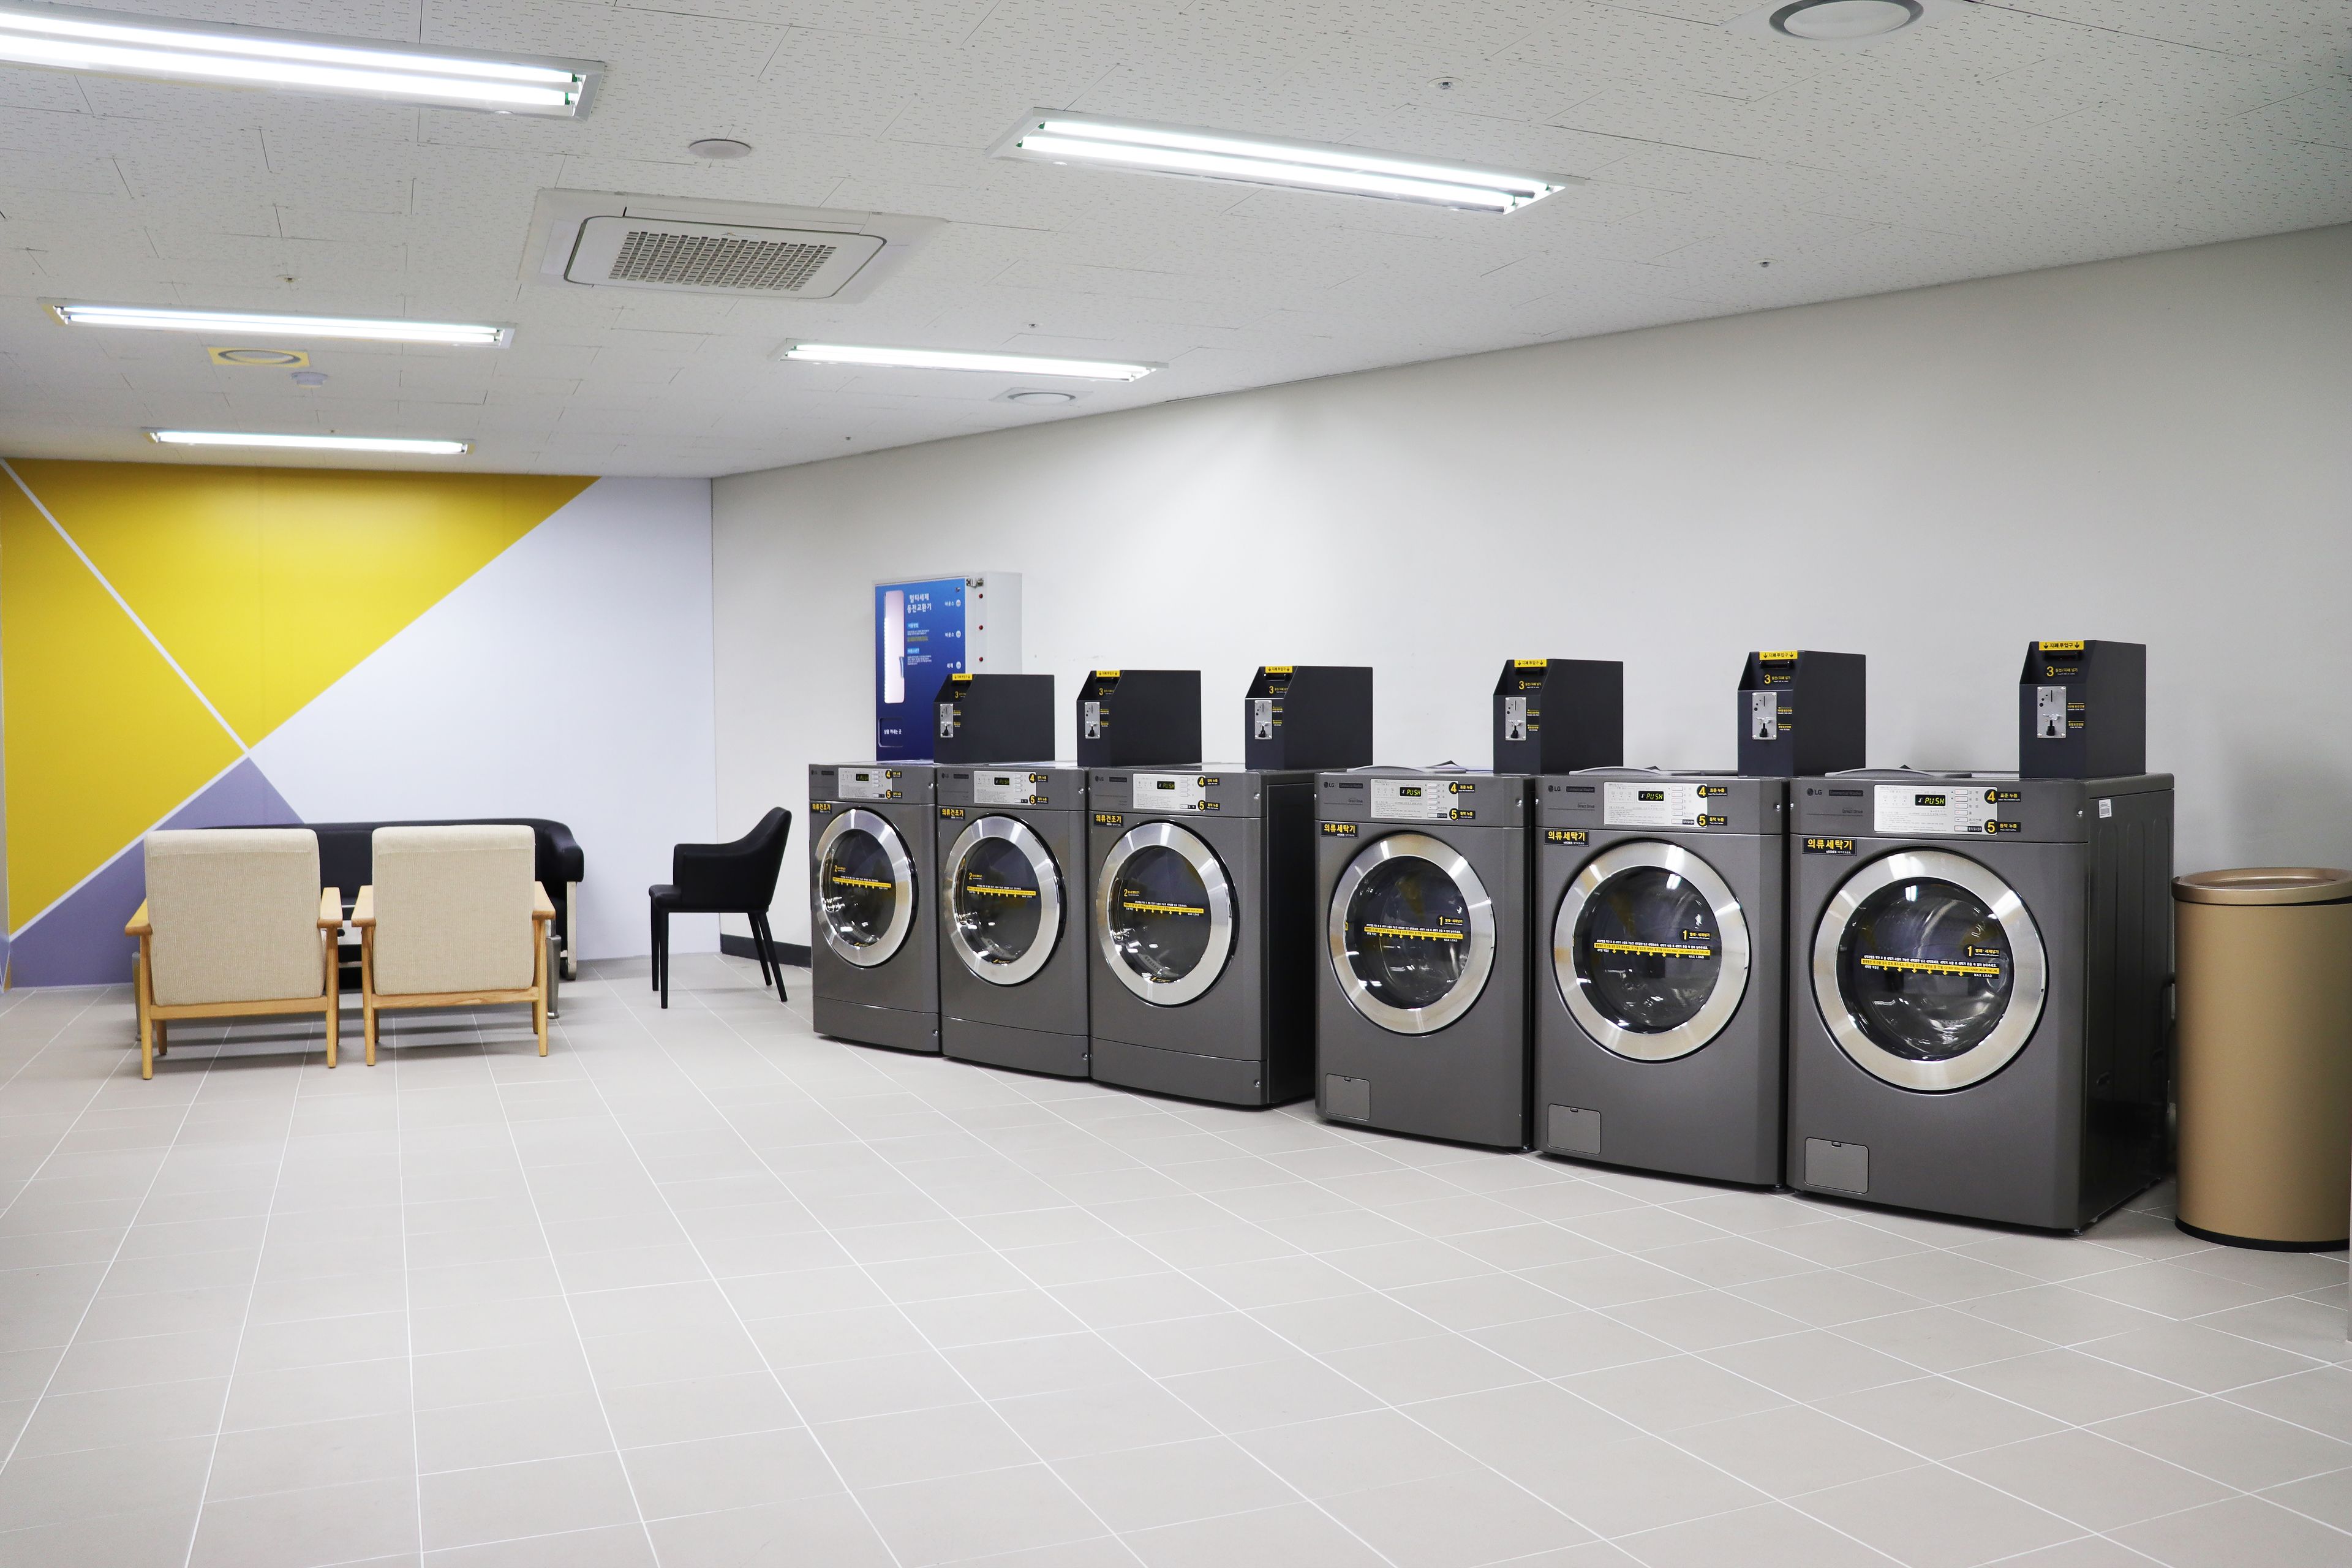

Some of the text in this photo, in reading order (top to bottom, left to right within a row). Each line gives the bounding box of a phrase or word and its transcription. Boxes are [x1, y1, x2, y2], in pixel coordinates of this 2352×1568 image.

[910, 593, 929, 603] 멀티세제
[907, 603, 932, 614] 동전교환기
[2046, 666, 2054, 677] 3
[1764, 674, 1771, 684] 3
[1268, 685, 1274, 694] 3
[1518, 680, 1525, 690] 3
[1199, 777, 1204, 786] 4
[1450, 783, 1457, 793] 4
[1698, 786, 1706, 796] 4
[1987, 791, 1996, 802] 4
[1199, 801, 1204, 810] 5
[1096, 814, 1121, 823] 의류건조기
[1451, 810, 1457, 819] 5
[1699, 815, 1706, 826] 5
[1324, 824, 1355, 834] 의류세탁기
[1987, 821, 1996, 832] 5
[1548, 831, 1585, 841] 의류세탁기
[1807, 839, 1852, 850] 의류세탁기
[1439, 916, 1443, 925] 1
[1683, 930, 1687, 940] 1
[1967, 946, 1972, 957] 1
